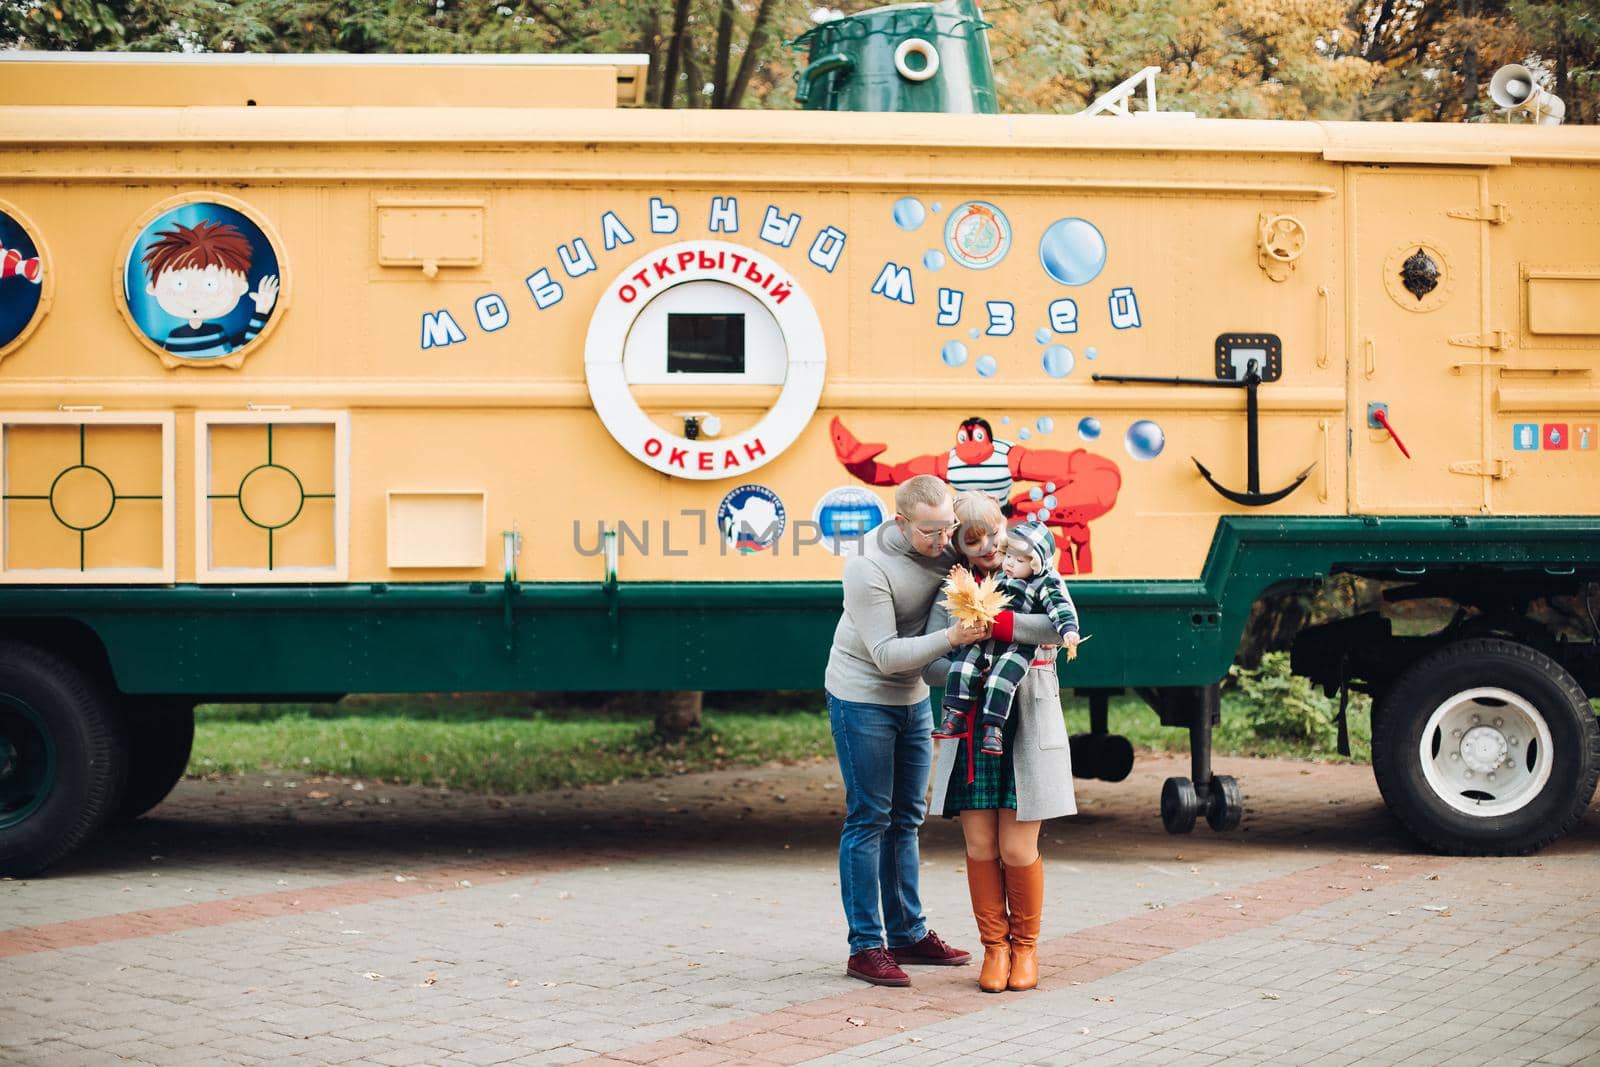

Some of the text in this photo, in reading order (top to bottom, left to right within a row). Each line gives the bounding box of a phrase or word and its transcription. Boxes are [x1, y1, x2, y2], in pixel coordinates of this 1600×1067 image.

[420, 196, 847, 350] МОБИЛЬНЫЙ
[618, 250, 795, 305] ОТКРЫТЫЙ
[643, 437, 767, 471] ОКЕАН
